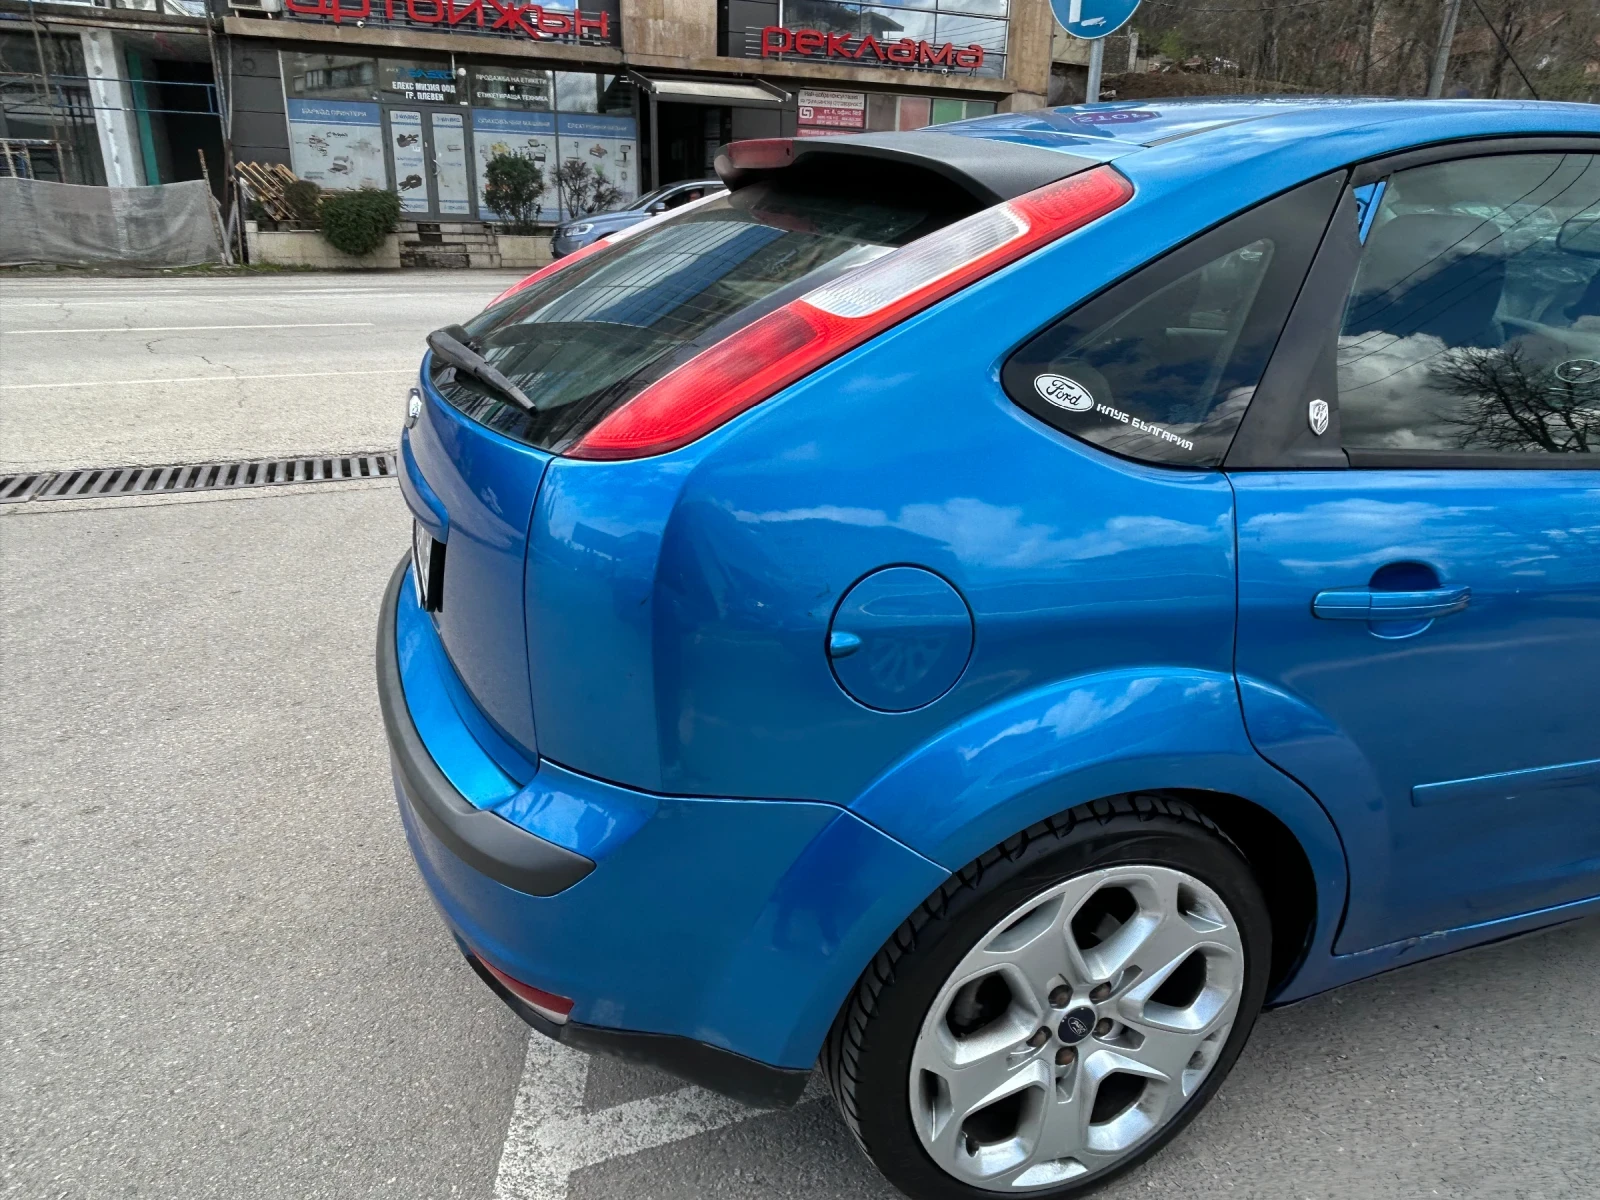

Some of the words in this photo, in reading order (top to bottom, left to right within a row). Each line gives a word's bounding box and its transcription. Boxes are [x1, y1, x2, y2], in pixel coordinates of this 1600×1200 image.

[761, 26, 984, 68] реклама
[441, 84, 456, 93] ООД
[417, 92, 444, 101] ПЛЕВЕН
[1096, 403, 1130, 424] КЛУБ
